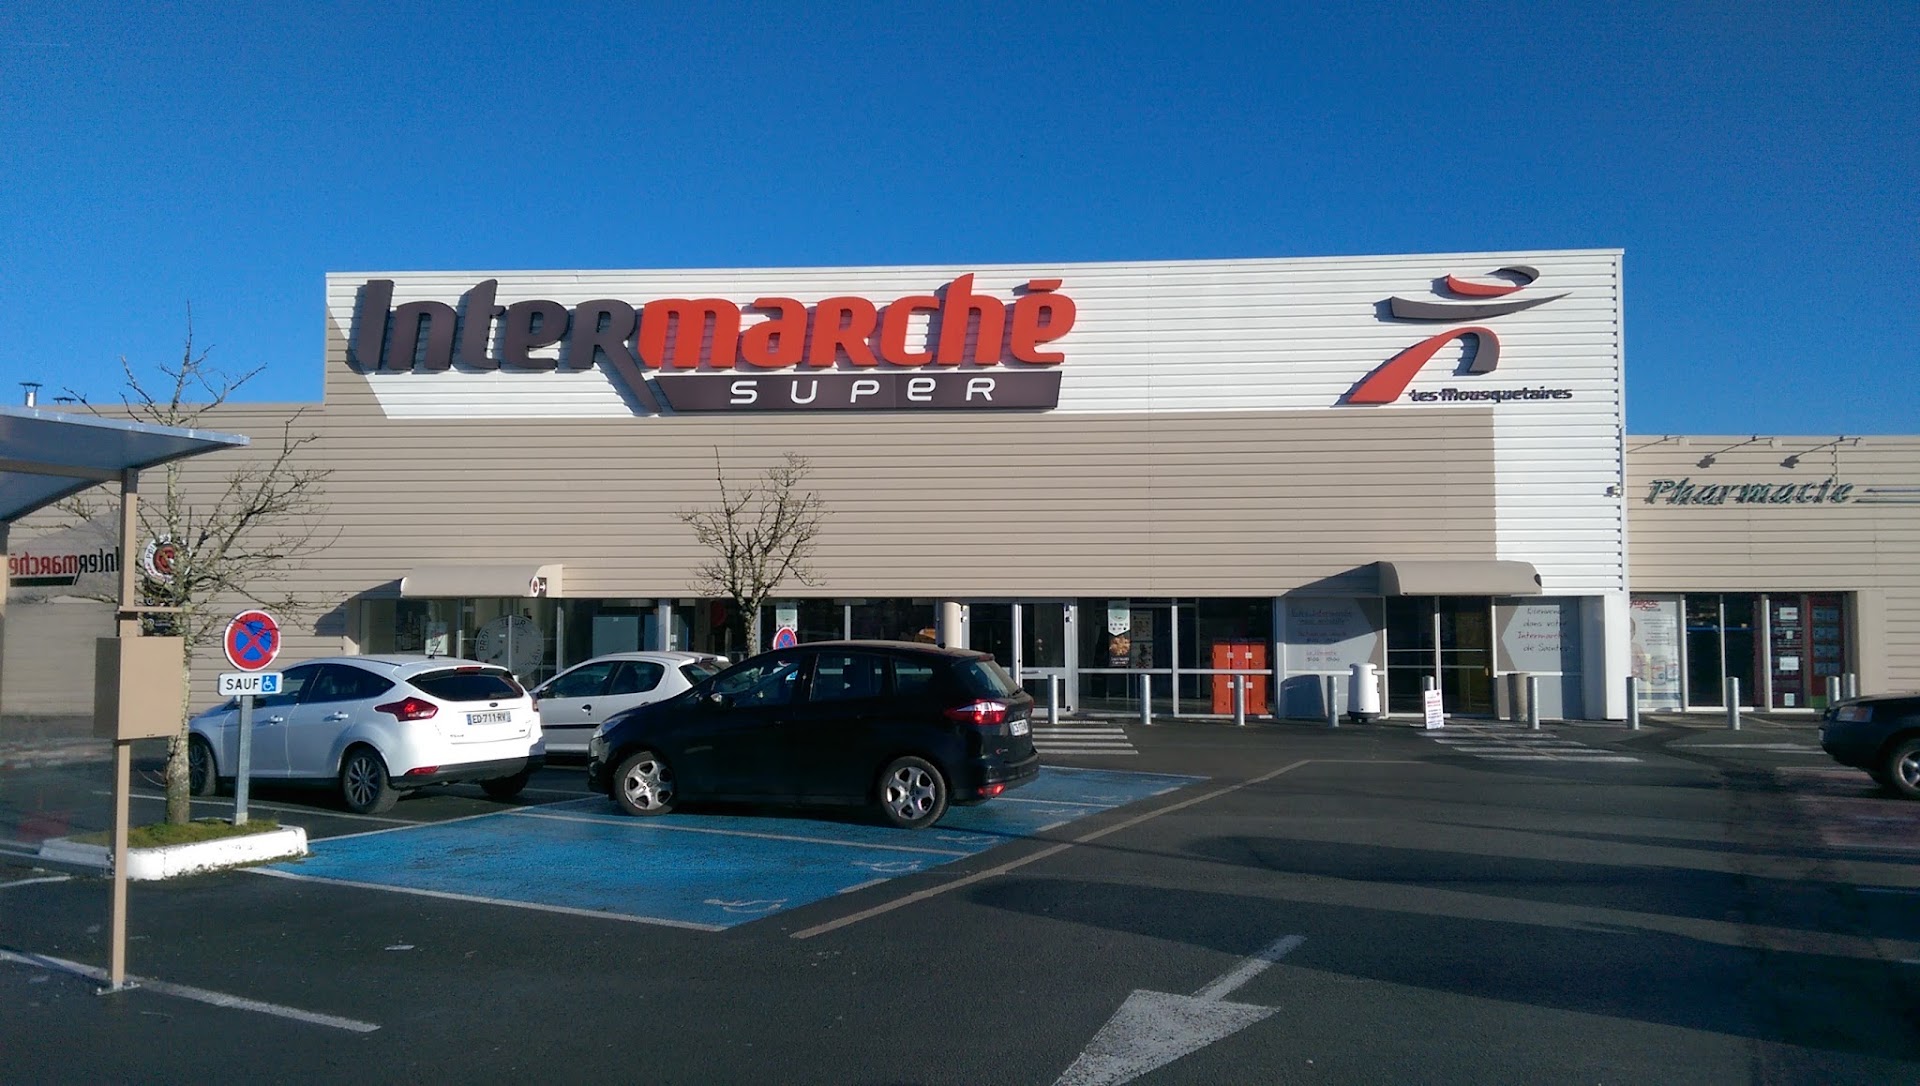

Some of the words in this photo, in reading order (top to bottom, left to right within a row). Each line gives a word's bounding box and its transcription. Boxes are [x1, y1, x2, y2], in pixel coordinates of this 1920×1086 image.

[354, 273, 1076, 413] Intermarché
[729, 376, 996, 405] SUPER
[1645, 477, 1854, 505] Pharmacie
[225, 677, 260, 690] SAUF
